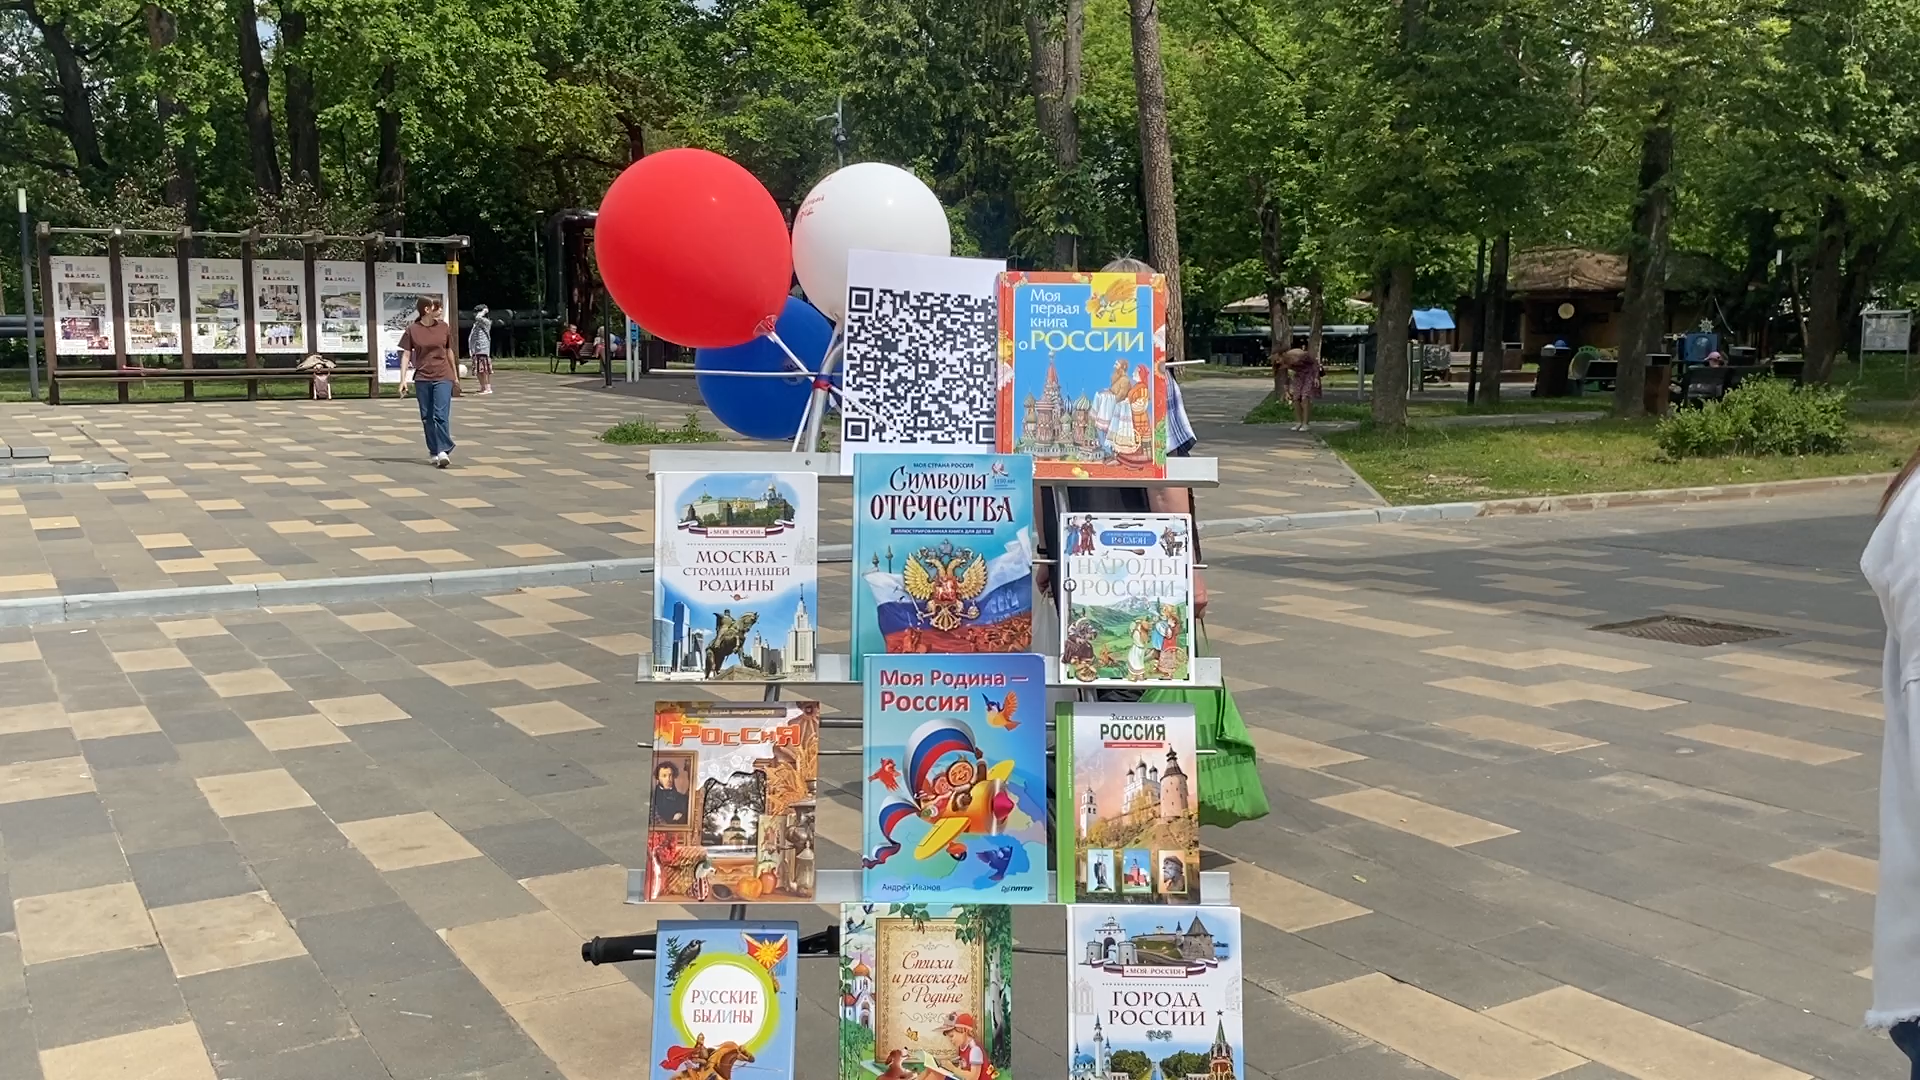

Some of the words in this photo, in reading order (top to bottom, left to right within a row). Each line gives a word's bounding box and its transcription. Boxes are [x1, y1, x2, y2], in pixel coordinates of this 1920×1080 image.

[1030, 289, 1061, 302] Моя
[1030, 303, 1080, 317] первая
[1030, 316, 1068, 328] книга
[1018, 340, 1028, 351] о
[1030, 330, 1144, 352] РОССИИ
[889, 465, 990, 494] Символы
[696, 550, 776, 564] МОСКВА
[682, 568, 744, 576] СТОЛИЦА
[746, 566, 790, 576] НАШЕЙ
[1077, 558, 1180, 578] НАРОДЫ
[699, 580, 774, 592] РОДИНЫ
[1080, 579, 1176, 597] РОССИИ
[880, 670, 924, 686] Моя
[930, 670, 1006, 688] Родина
[880, 691, 970, 712] Россия
[1100, 724, 1166, 740] РОССИЯ
[882, 884, 910, 892] Андрей
[902, 950, 954, 970] Стихи
[892, 974, 900, 984] и
[901, 973, 969, 990] рассказы
[691, 990, 758, 1005] РУССКИЕ
[902, 991, 910, 1002] о
[912, 984, 963, 1008] Родине
[1112, 991, 1202, 1008] ГОРОДА
[692, 1008, 754, 1024] БЫЛИНЫ
[1108, 1010, 1206, 1026] РОССИИ
